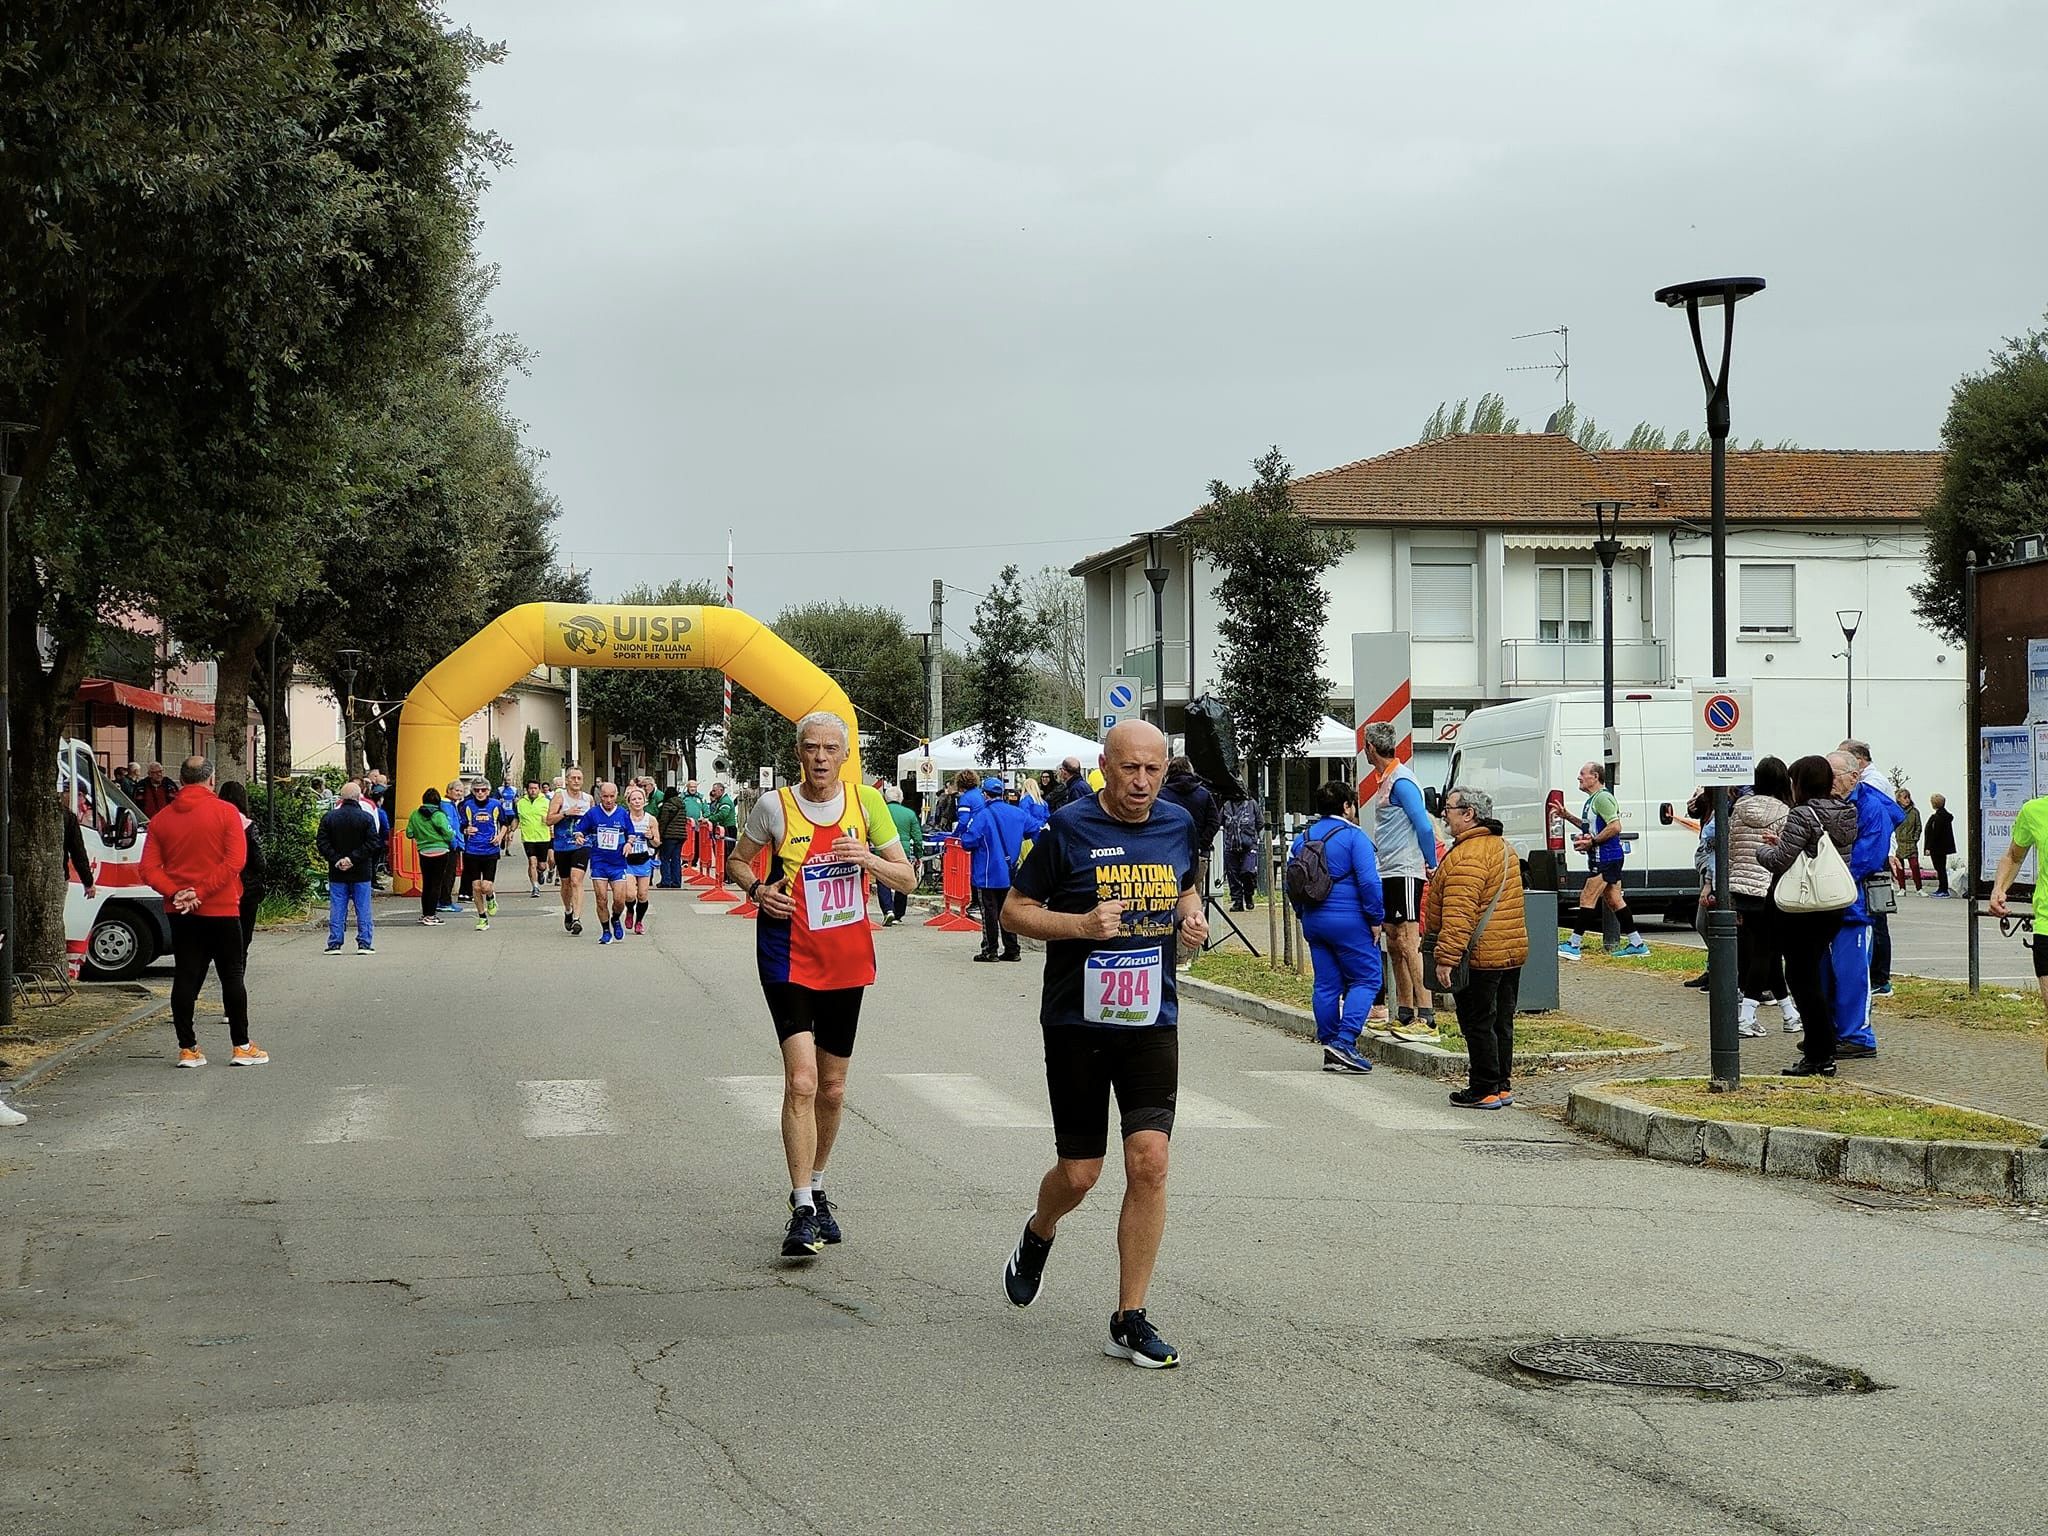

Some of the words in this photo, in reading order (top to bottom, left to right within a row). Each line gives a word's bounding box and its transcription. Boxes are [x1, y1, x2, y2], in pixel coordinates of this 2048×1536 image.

[613, 616, 692, 642] UISP
[613, 643, 648, 652] UNIONE
[651, 644, 692, 652] ITALIANA
[613, 652, 640, 660] SPORT
[644, 652, 660, 660] PER
[1105, 716, 1114, 727] P
[1987, 825, 2011, 836] ALVISI
[602, 833, 615, 844] 214
[790, 835, 811, 845] AVIS
[1095, 864, 1177, 884] MARATONA
[818, 876, 855, 912] 207
[1120, 882, 1133, 898] DI
[1134, 882, 1179, 898] RAVENNA
[1149, 898, 1178, 912] D'ART
[1114, 955, 1159, 967] MIZUNO
[1100, 969, 1150, 1007] 284
